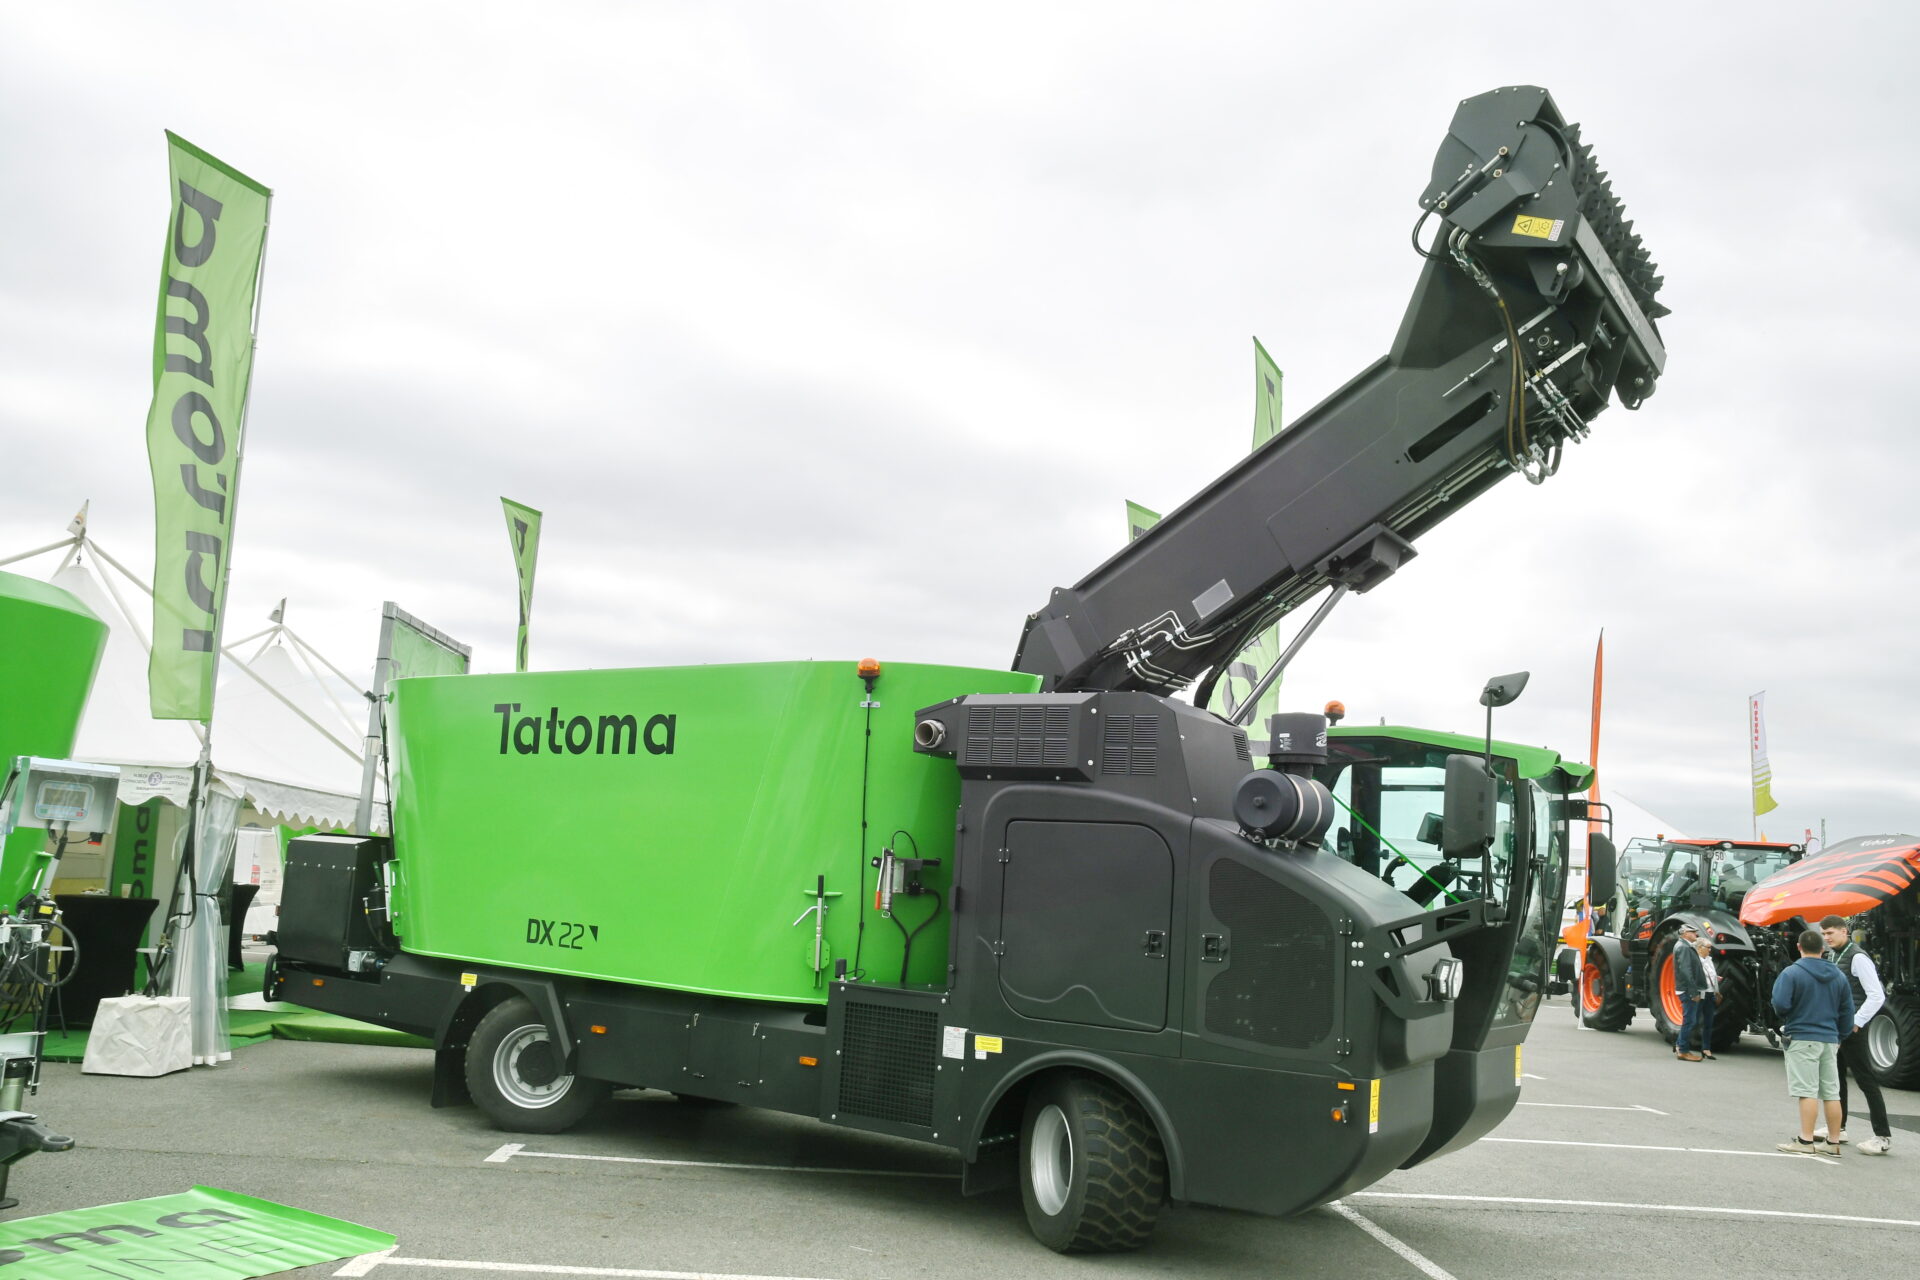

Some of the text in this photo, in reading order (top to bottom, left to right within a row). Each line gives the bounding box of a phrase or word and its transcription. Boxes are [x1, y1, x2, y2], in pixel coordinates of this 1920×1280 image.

[493, 703, 677, 755] Tatoma
[526, 918, 585, 950] DX 22
